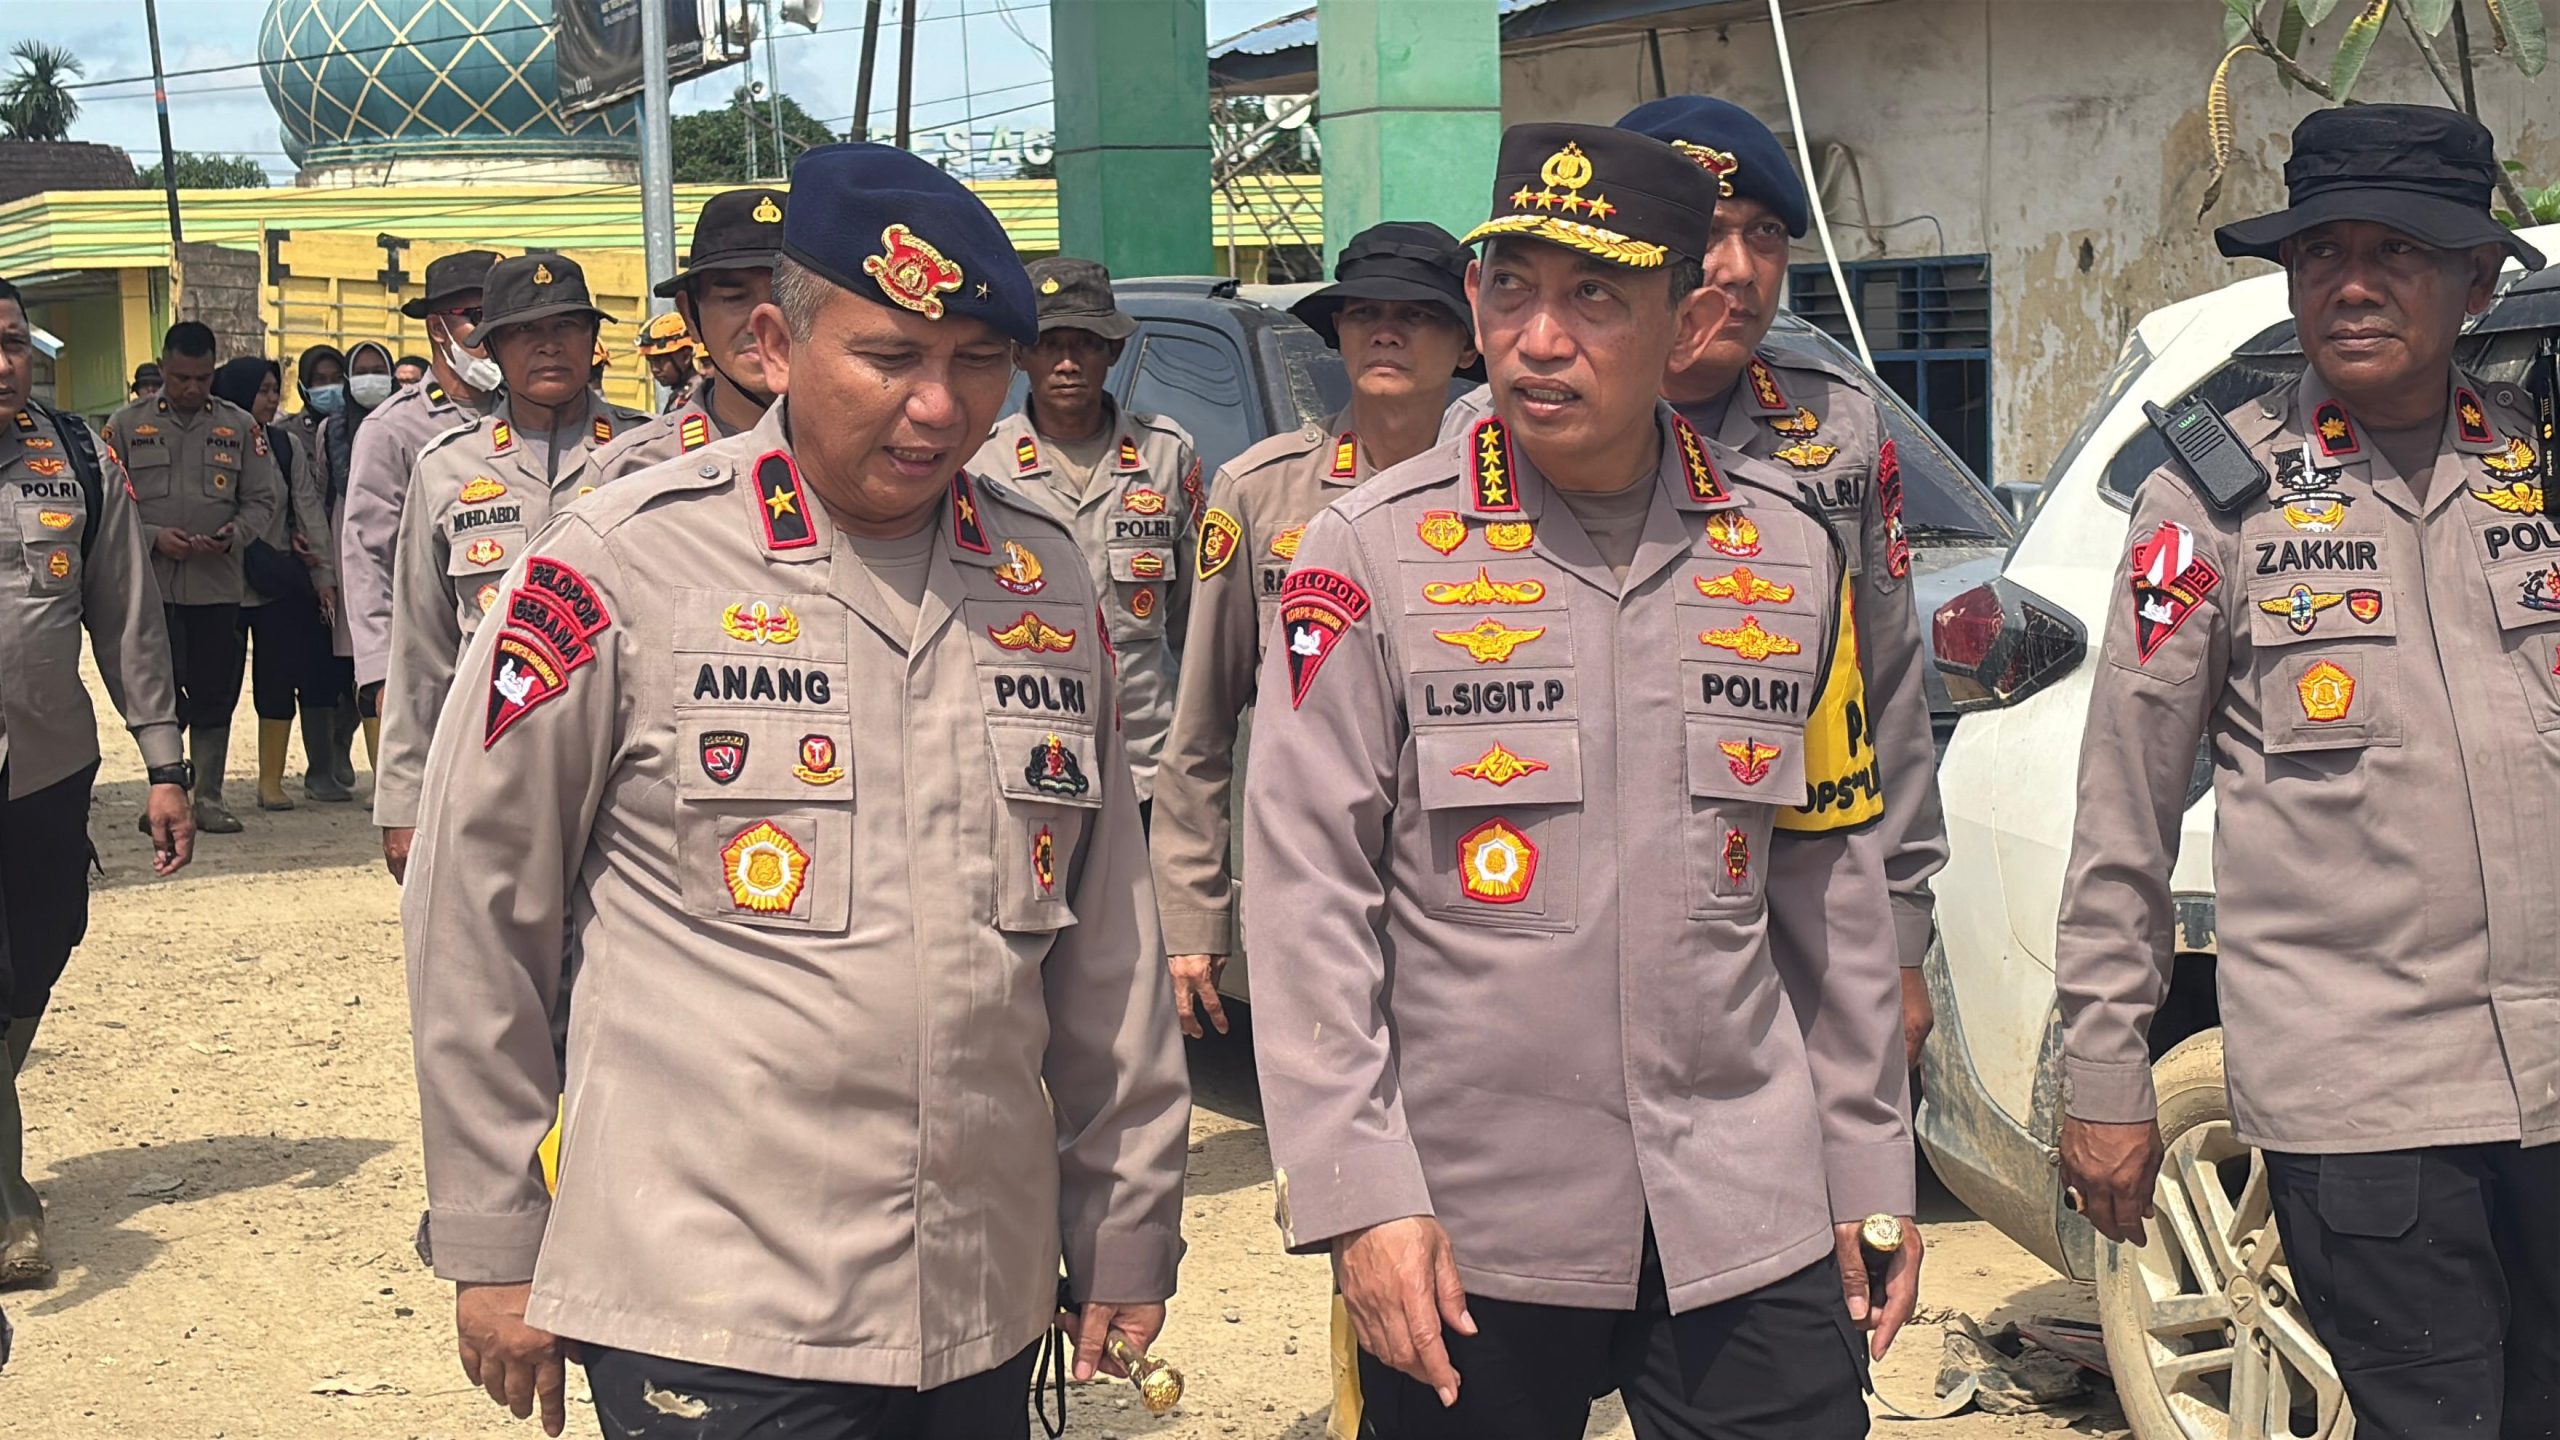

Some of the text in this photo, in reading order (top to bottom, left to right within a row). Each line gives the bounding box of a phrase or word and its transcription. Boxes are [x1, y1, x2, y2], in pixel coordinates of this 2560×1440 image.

[206, 438, 241, 449] POLRI
[22, 482, 77, 498] POLRI
[1815, 476, 1860, 507] LRI
[1115, 520, 1170, 537] POLRI
[2255, 539, 2377, 575] ZAKKIR
[529, 564, 601, 631] PELOPOR
[1286, 573, 1360, 611] PELOPOR
[513, 597, 582, 663] GEGANA
[694, 664, 831, 704] ANANG
[994, 674, 1086, 714] POLRI
[1425, 679, 1564, 716] L.SIGIT.P
[1702, 673, 1799, 713] POLRI
